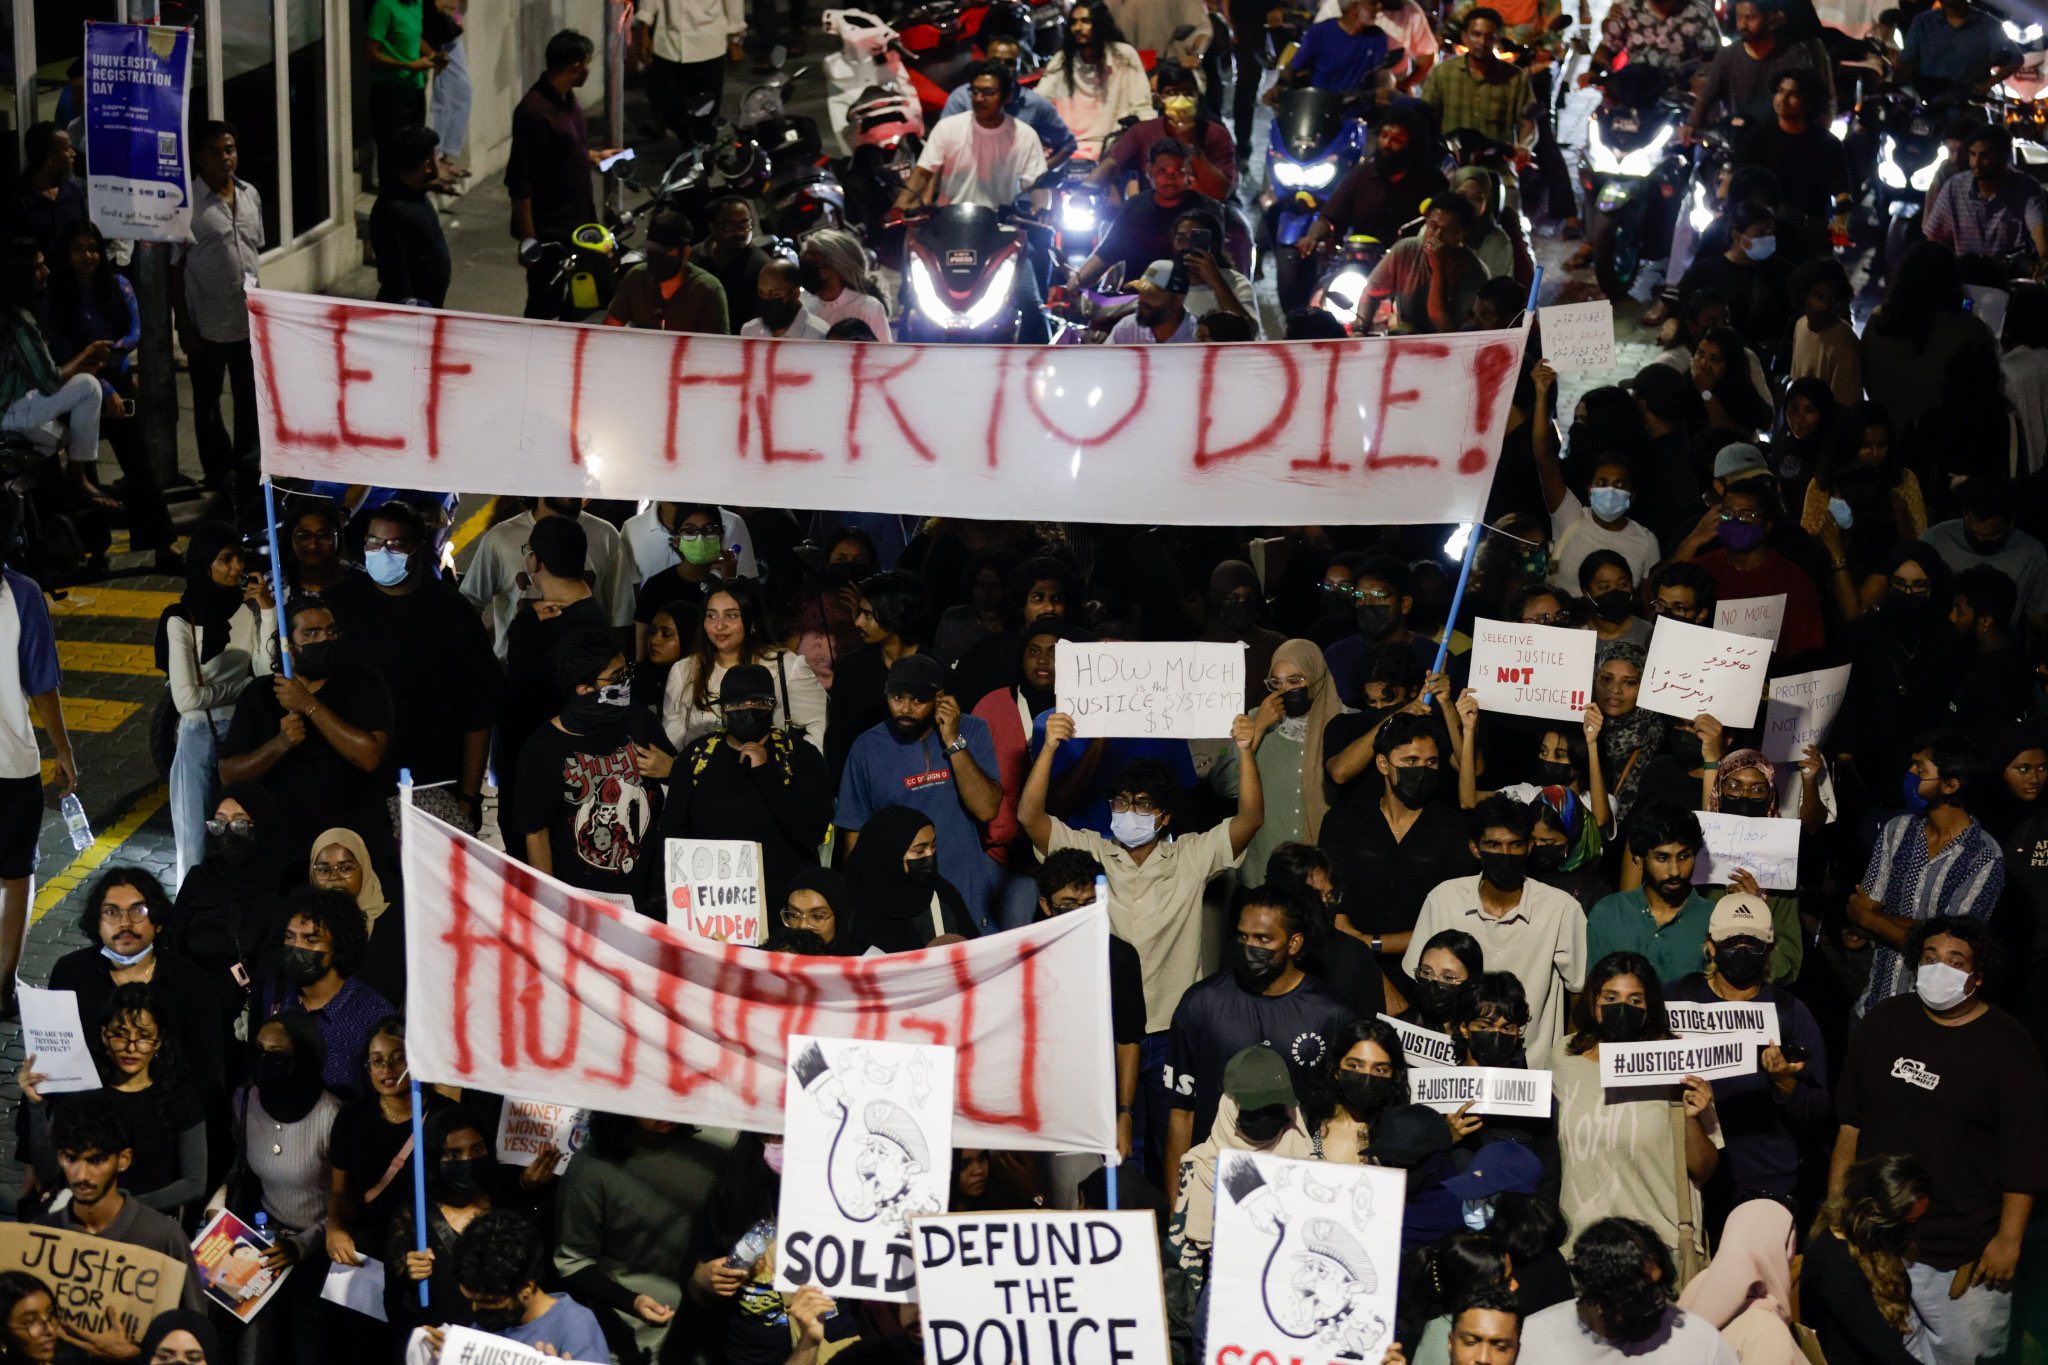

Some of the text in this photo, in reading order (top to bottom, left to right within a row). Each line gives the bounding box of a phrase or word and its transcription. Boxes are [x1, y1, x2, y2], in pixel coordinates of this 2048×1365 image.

[93, 54, 158, 71] UNIVERSITY
[93, 68, 172, 87] REGISTRATION
[93, 82, 114, 95] DAY
[661, 334, 938, 463] HER
[1193, 341, 1513, 476] DIE!
[1720, 604, 1773, 627] NO MORE
[1481, 632, 1534, 646] SELECTIVE
[1515, 649, 1565, 666] JUSTICE
[1075, 652, 1235, 691] HOW MUCH
[1478, 664, 1535, 686] IS NOT
[1136, 680, 1170, 693] is the
[1775, 680, 1821, 700] PROTECT
[1063, 690, 1243, 718] JUSTICE SYSTEM?
[1772, 717, 1798, 733] NOT
[670, 840, 753, 883] KOBA
[1732, 912, 1755, 920] adidas
[29, 1028, 74, 1039] WHO ARE YOU
[34, 1037, 60, 1045] TRYING
[35, 1045, 72, 1053] PROTECT?
[1291, 1032, 1327, 1067] PURSUE PASSION
[1614, 1042, 1744, 1074] #JUSTICE4YUMNU
[920, 1221, 1123, 1269] DEFUND
[782, 1231, 917, 1294] SOLD
[55, 1283, 104, 1310] FOR
[994, 1277, 1079, 1315] THE
